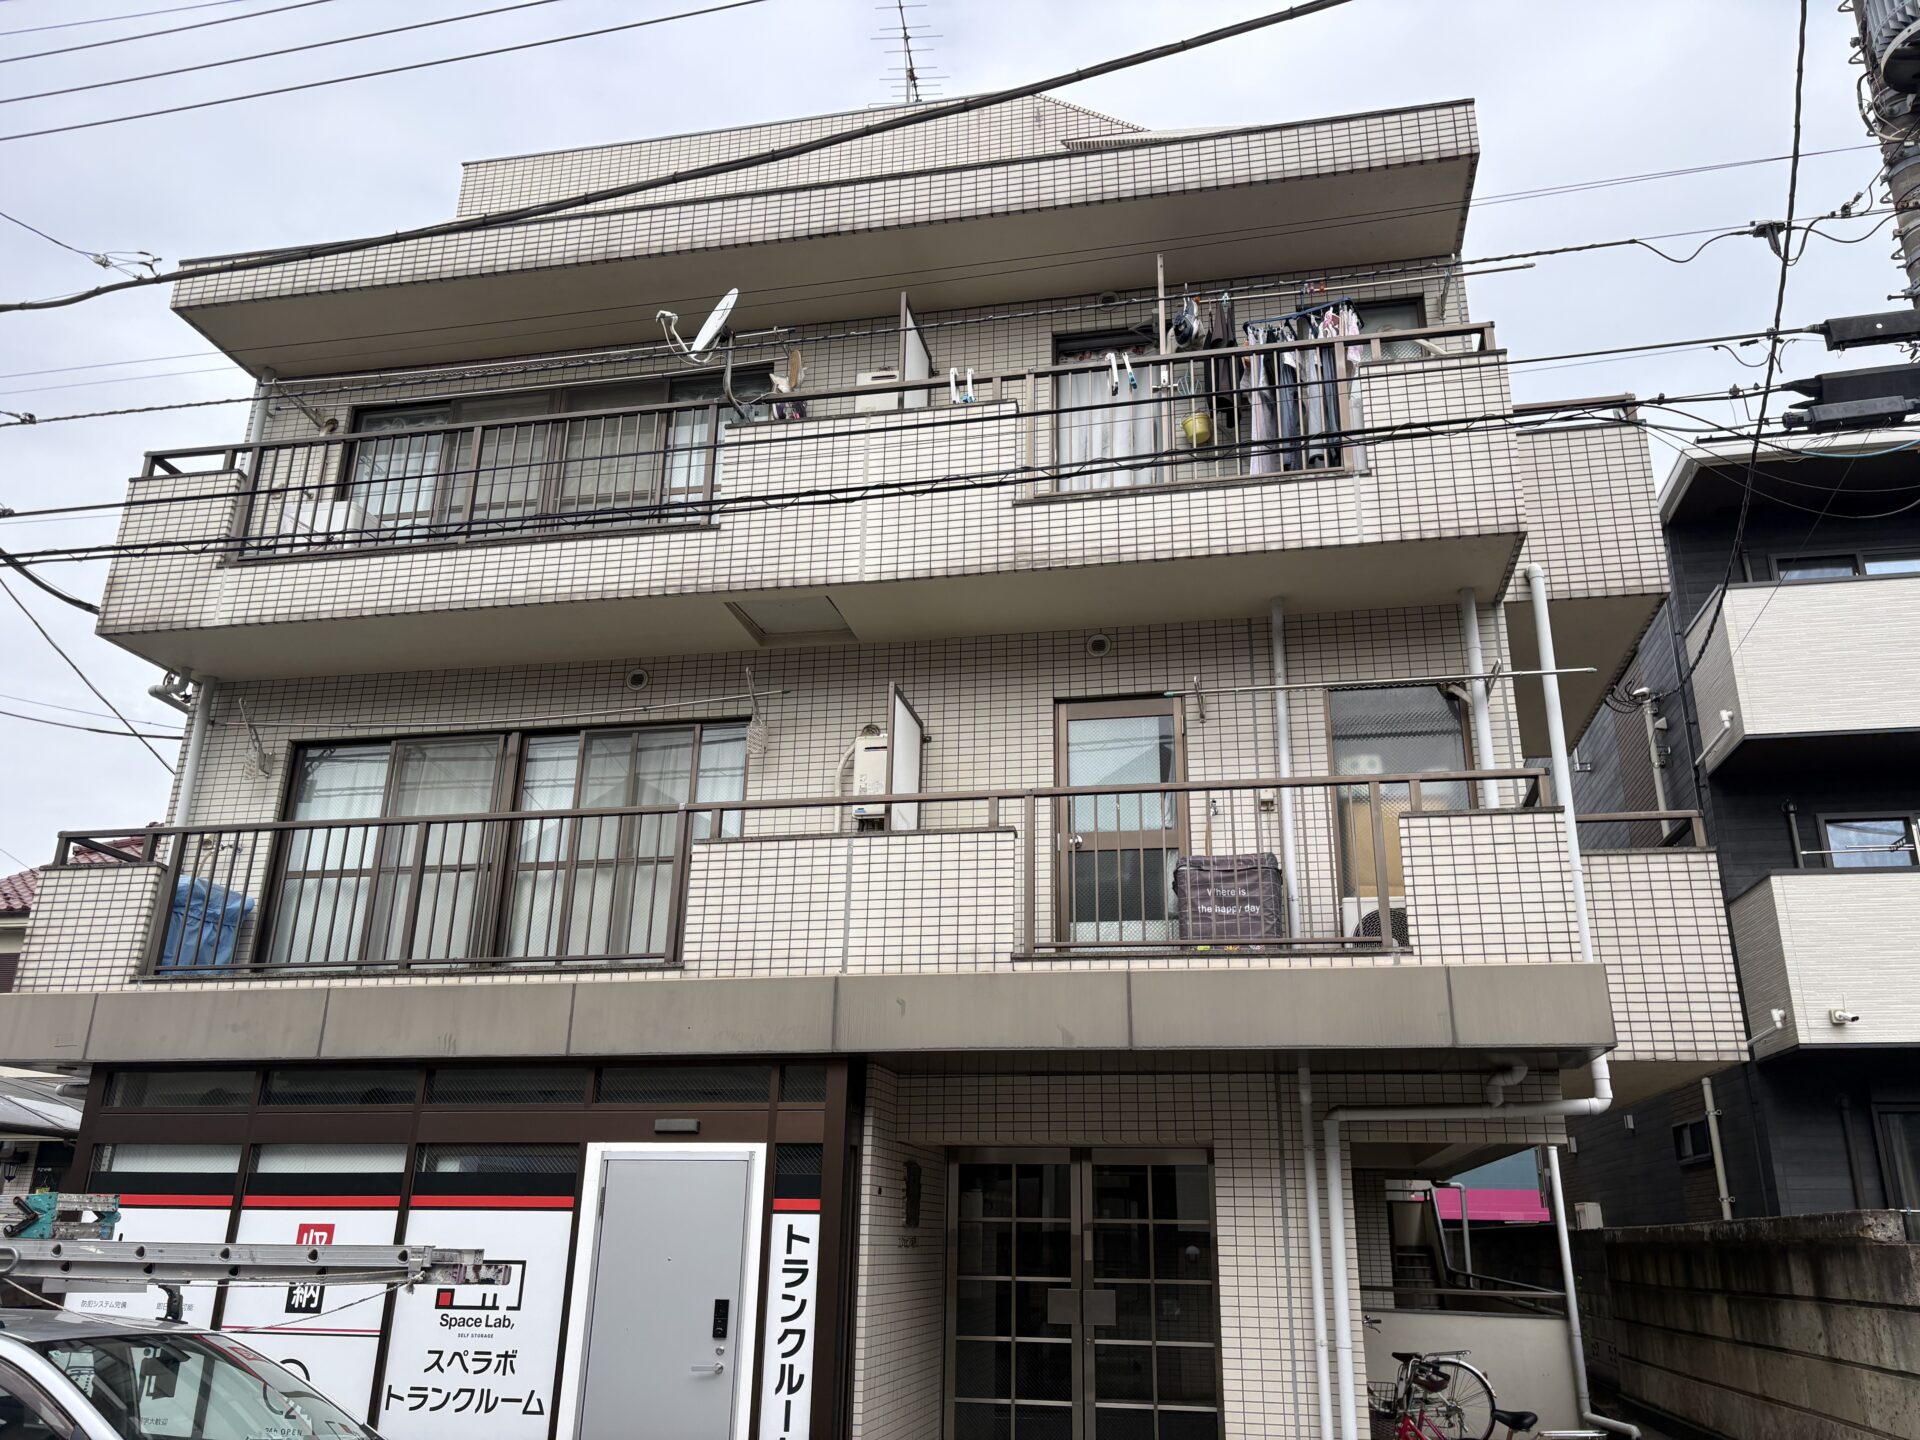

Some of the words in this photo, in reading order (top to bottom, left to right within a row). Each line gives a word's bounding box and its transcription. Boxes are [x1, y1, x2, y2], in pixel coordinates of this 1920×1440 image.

[1238, 887, 1247, 896] is
[1198, 904, 1213, 913] the
[1244, 903, 1260, 914] day
[439, 1313, 483, 1330] Space
[485, 1313, 515, 1330] Lab,
[775, 1224, 810, 1440] トランクルー
[423, 1349, 518, 1377] スペラボ
[385, 1384, 545, 1416] トランクルーム
[280, 1428, 303, 1436] OPEN
